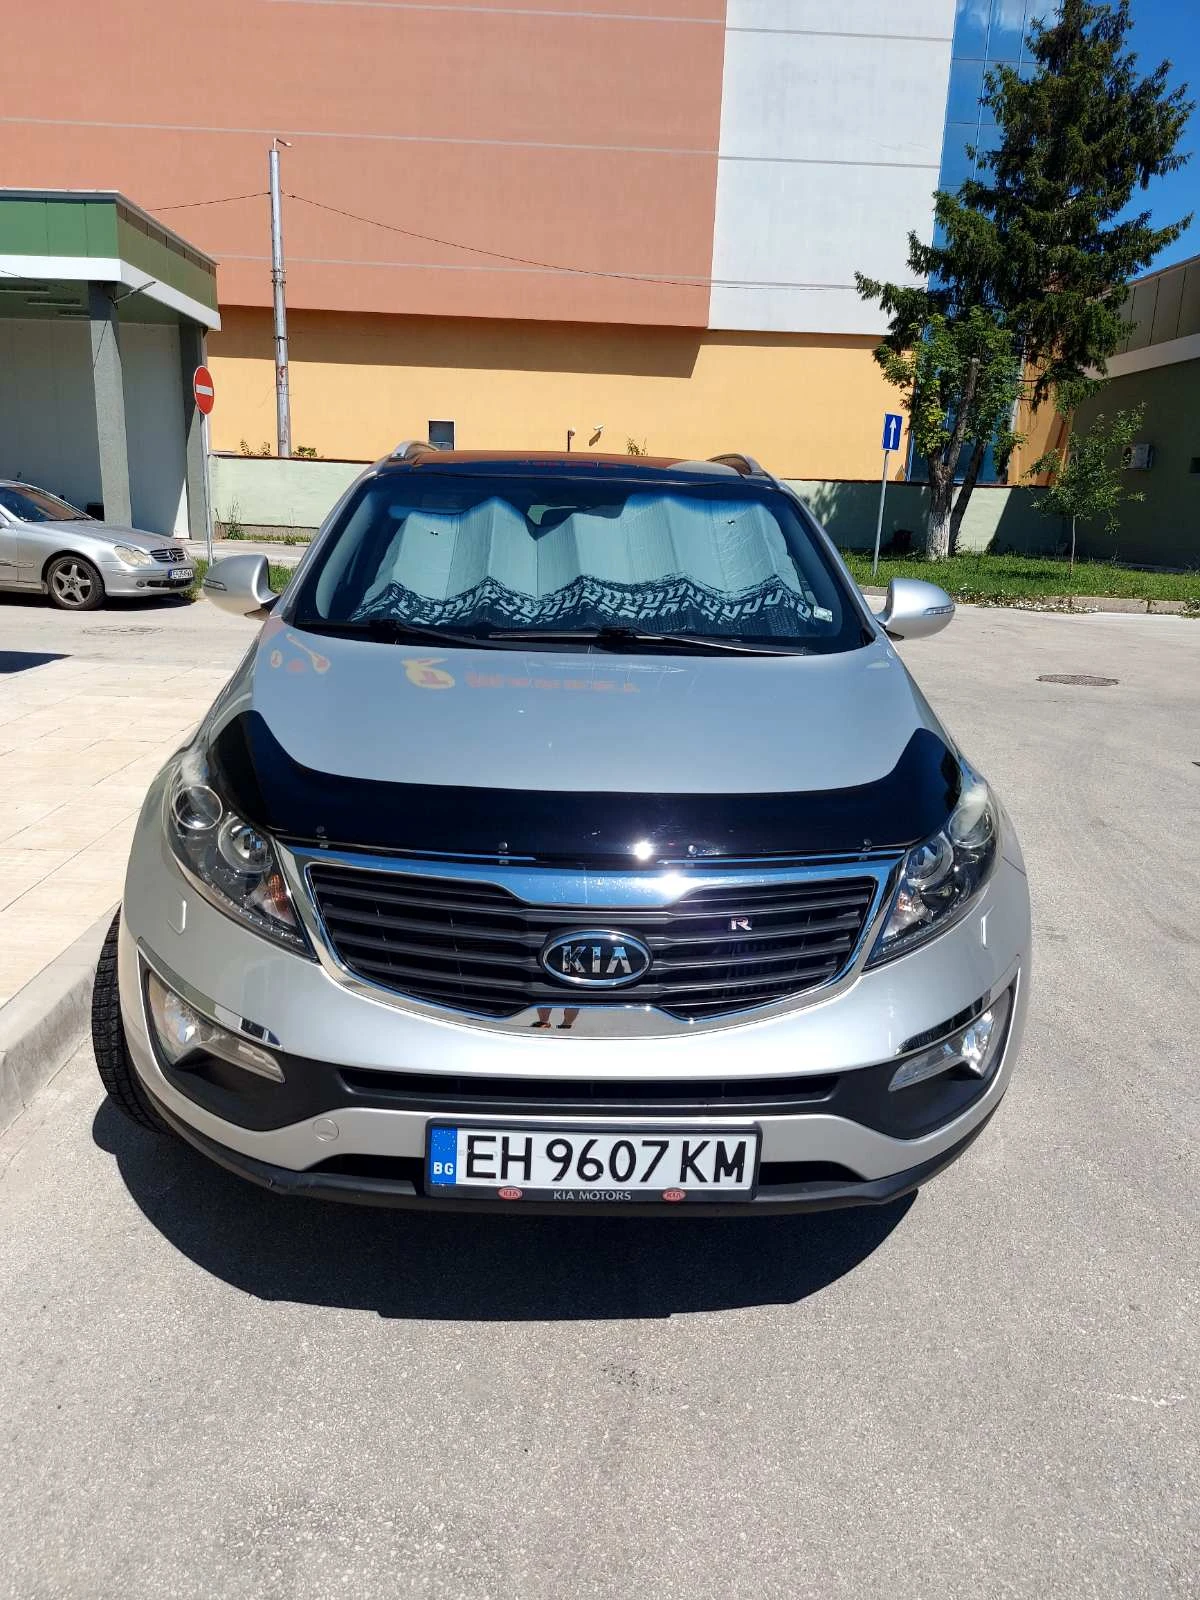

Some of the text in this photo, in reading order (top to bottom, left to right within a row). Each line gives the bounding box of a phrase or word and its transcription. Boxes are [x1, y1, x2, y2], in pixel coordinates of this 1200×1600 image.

[730, 917, 752, 931] R
[561, 945, 633, 974] KIA
[465, 1134, 747, 1183] EH 9607 KM
[433, 1162, 454, 1175] BG
[553, 1190, 632, 1200] KIA MOTORS
